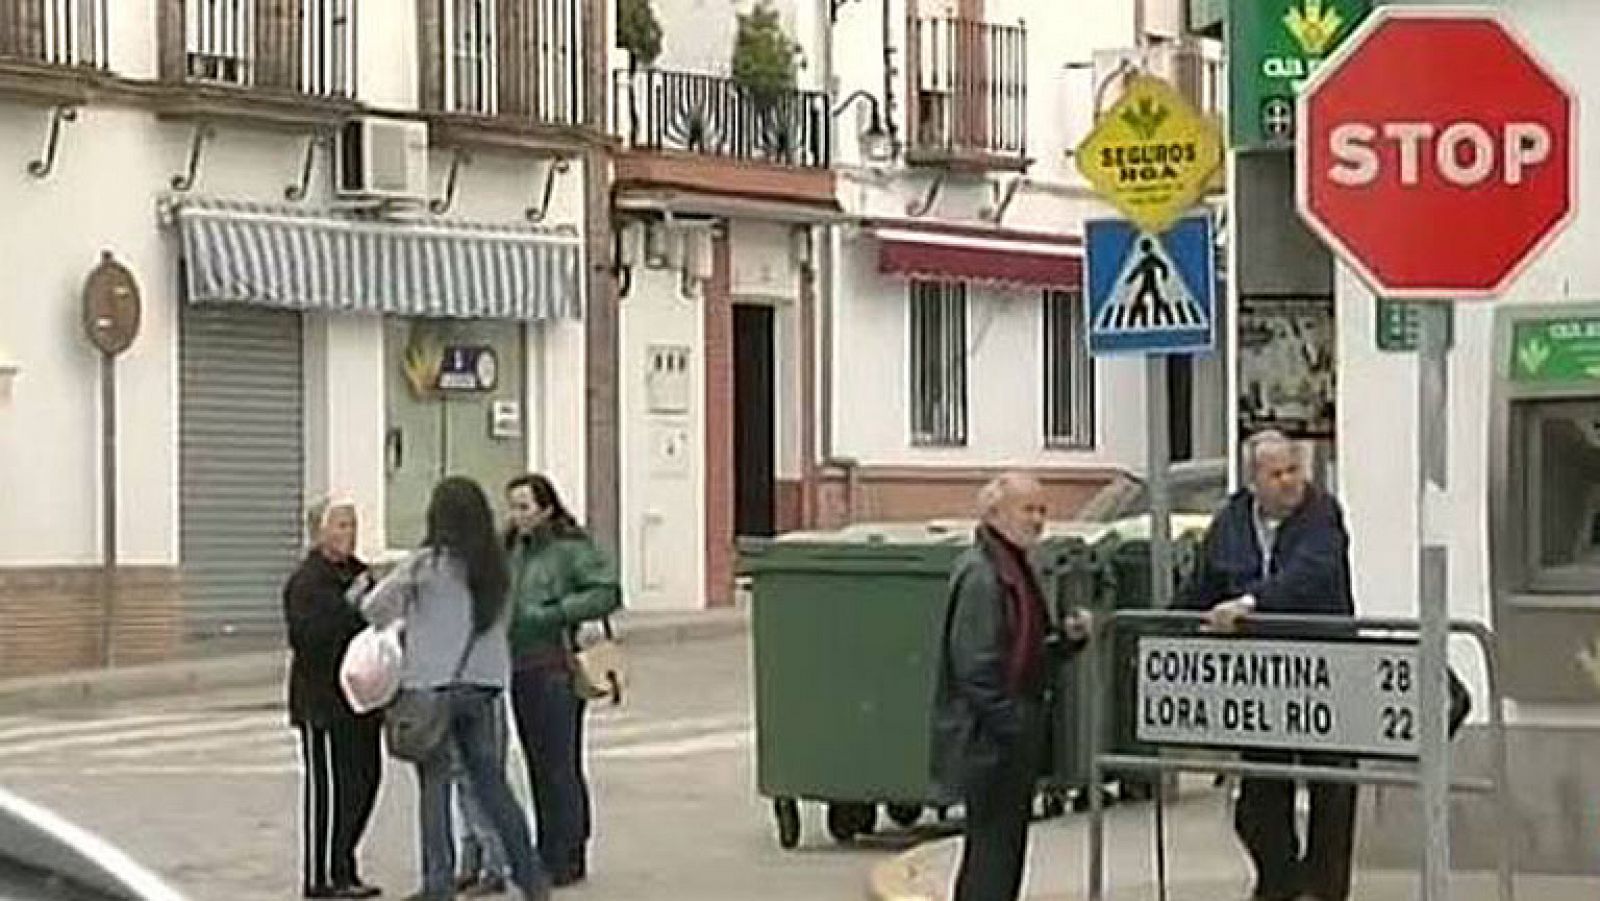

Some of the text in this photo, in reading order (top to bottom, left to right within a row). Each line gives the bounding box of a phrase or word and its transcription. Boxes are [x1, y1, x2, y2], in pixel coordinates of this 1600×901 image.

[1101, 143, 1196, 168] SEGUROS
[1328, 122, 1551, 186] STOP
[1147, 651, 1411, 693] CONSTANTINA 28
[1145, 693, 1414, 740] LORA DEL RÍO 22
